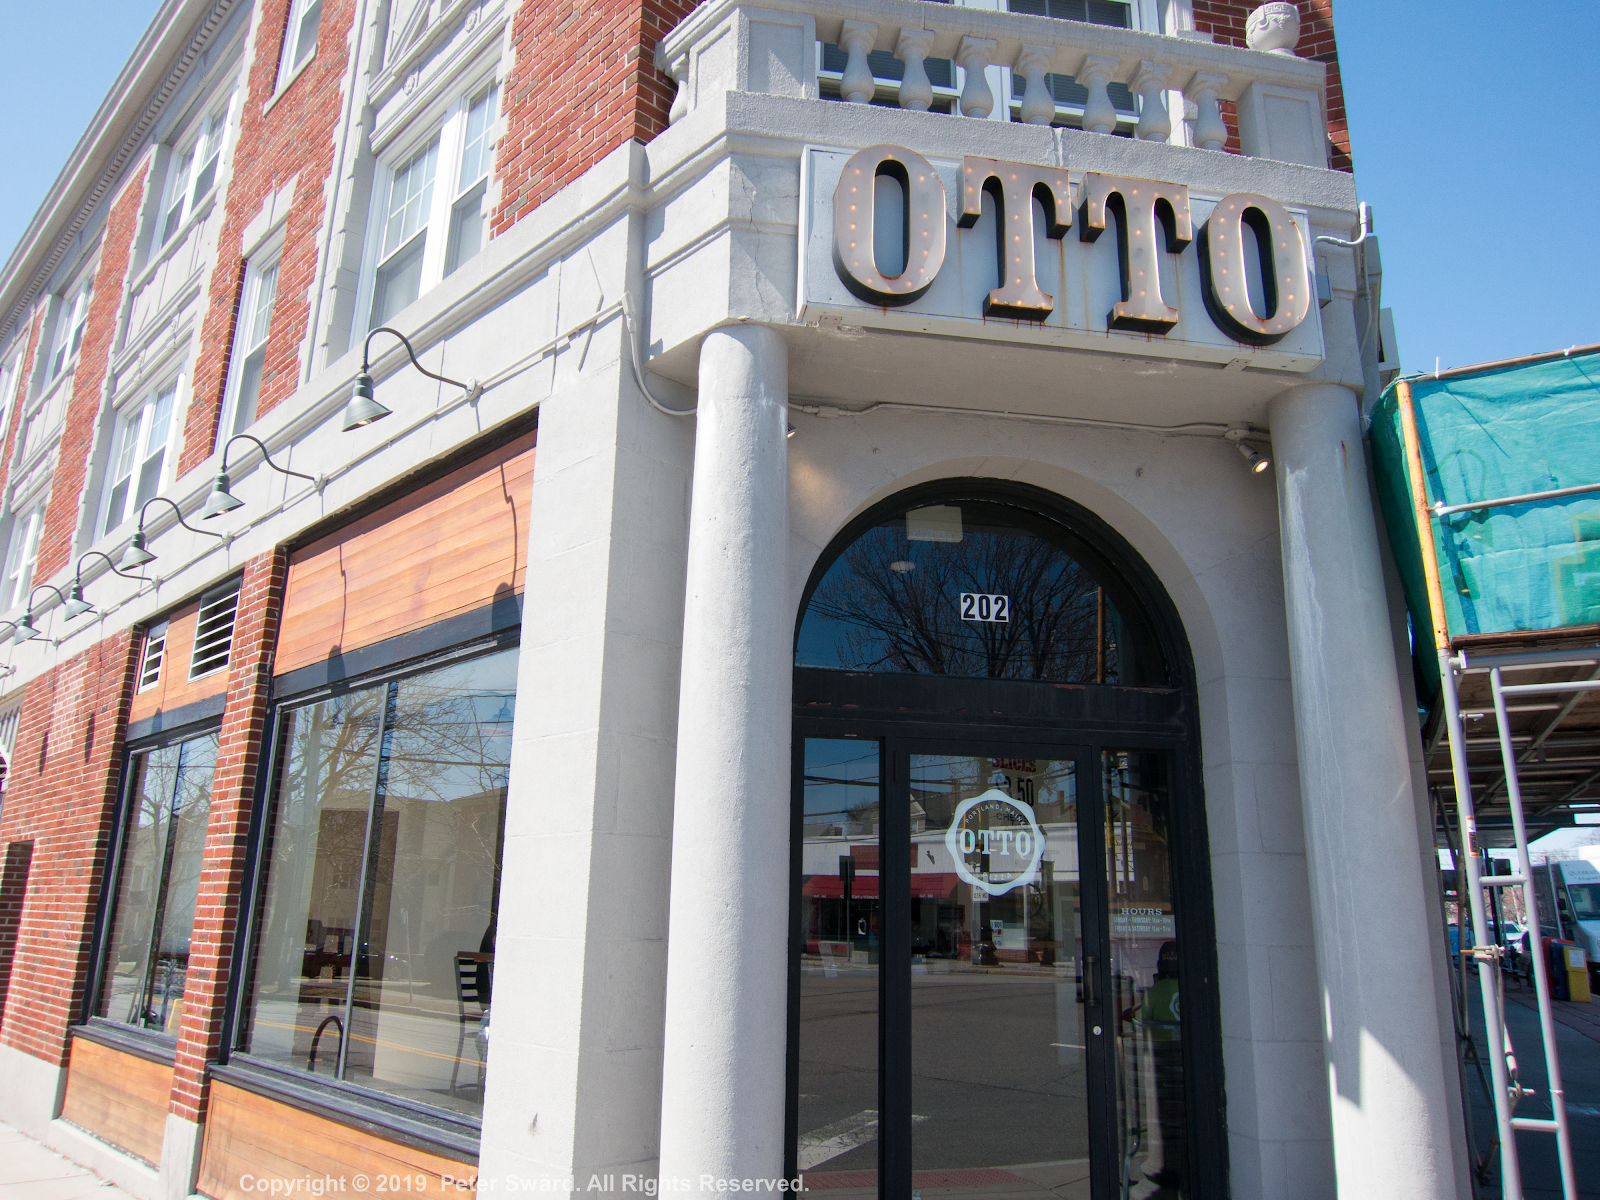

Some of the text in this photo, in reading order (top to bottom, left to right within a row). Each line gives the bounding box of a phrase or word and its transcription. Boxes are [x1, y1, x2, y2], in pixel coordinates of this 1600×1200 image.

[832, 144, 1310, 347] OTTO
[963, 594, 1007, 621] 202
[959, 828, 1032, 857] OTTO
[983, 872, 1013, 881] PIZZA
[1121, 907, 1163, 916] HOURS
